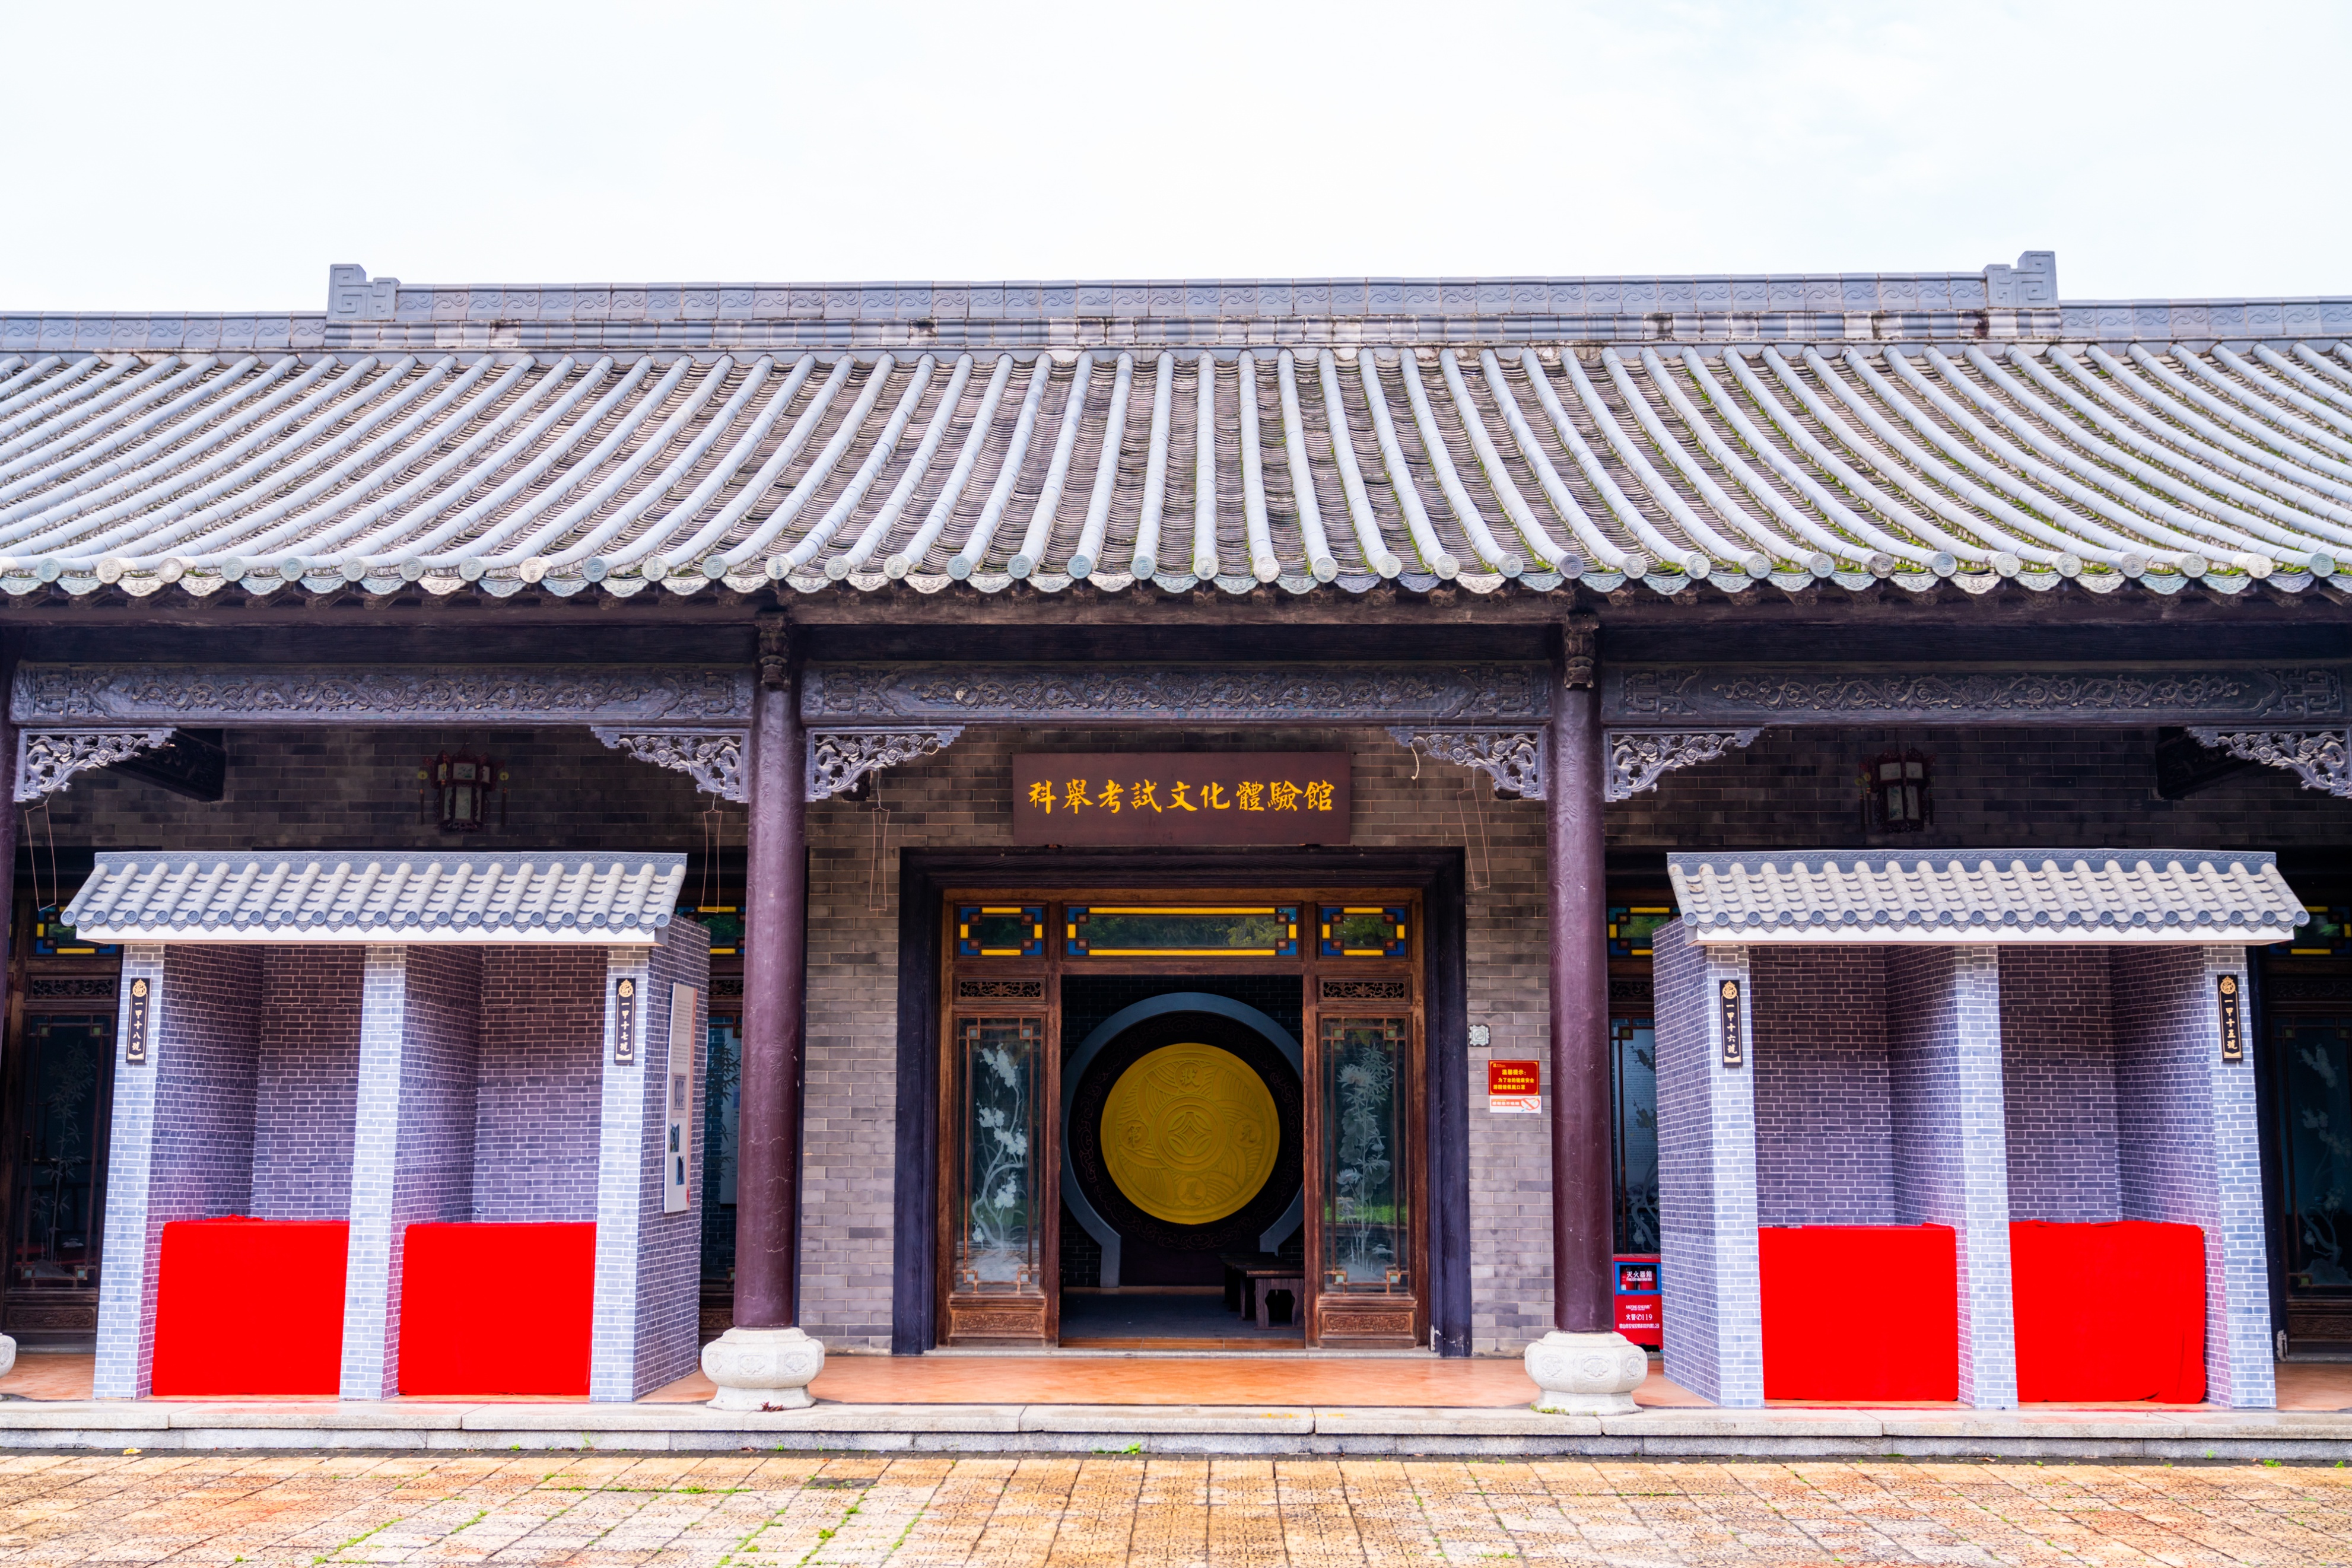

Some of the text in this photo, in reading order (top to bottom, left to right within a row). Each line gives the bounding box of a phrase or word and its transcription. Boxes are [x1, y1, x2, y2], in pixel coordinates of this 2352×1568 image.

[1028, 778, 1335, 815] 科舉考試文化體驗館
[132, 1001, 144, 1051] 一甲十八號
[619, 1002, 630, 1051] 一甲十七號
[1725, 1004, 1737, 1054] 一甲十六號
[2224, 999, 2237, 1049] 一甲十五號
